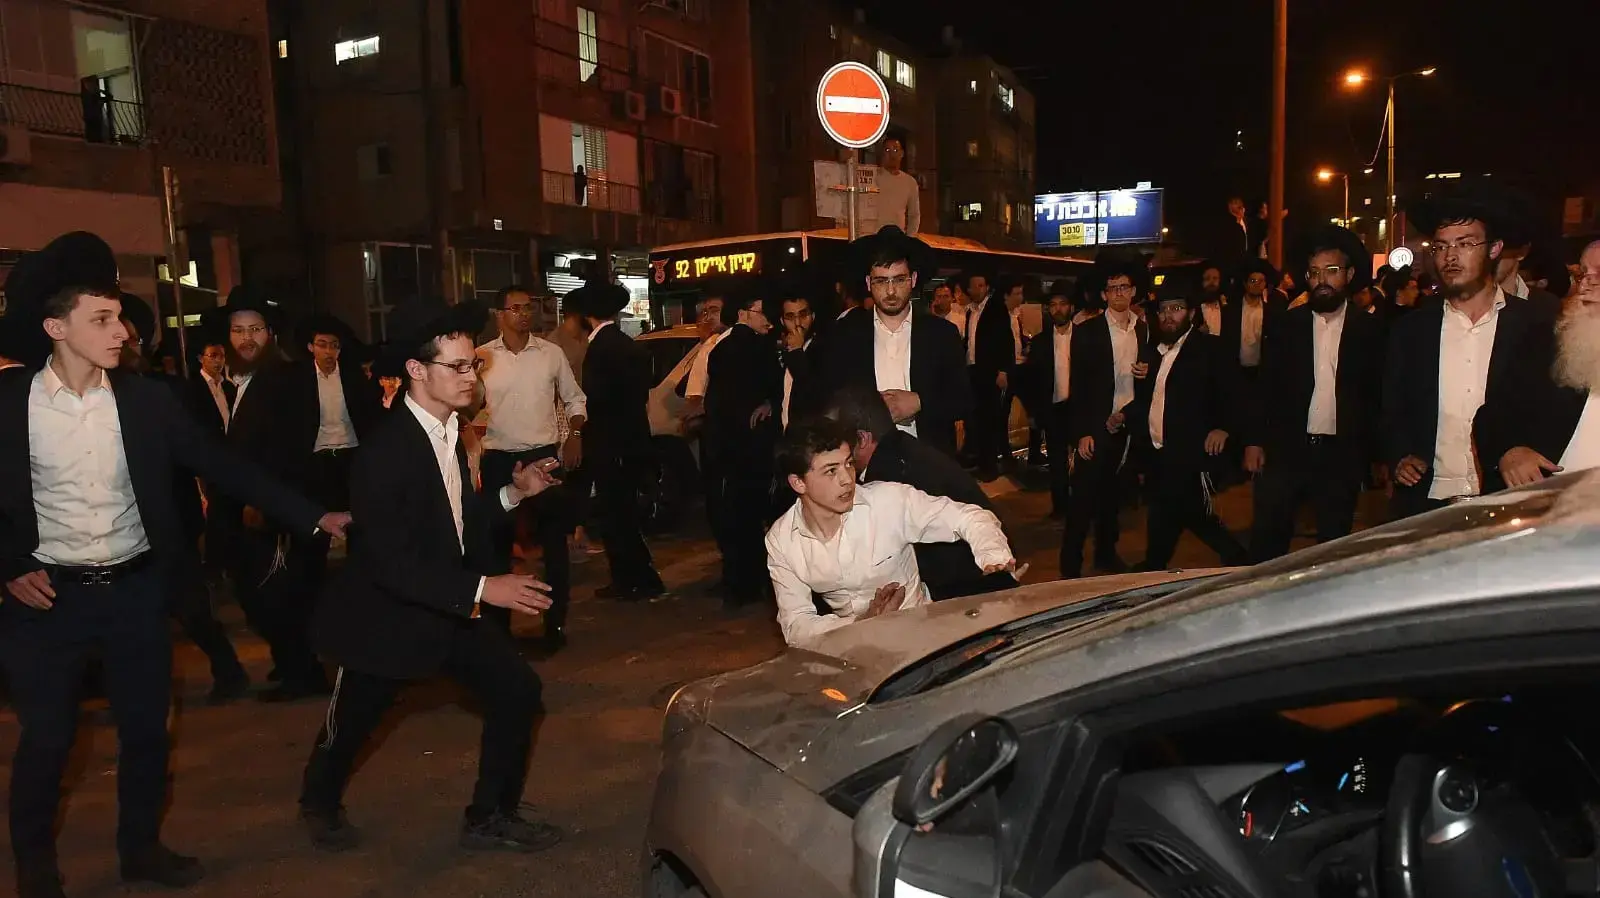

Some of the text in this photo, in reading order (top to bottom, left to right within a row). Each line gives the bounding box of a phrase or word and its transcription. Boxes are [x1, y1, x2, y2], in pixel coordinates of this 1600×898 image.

[675, 260, 690, 278] 92
[695, 253, 755, 277] קניון איילון
